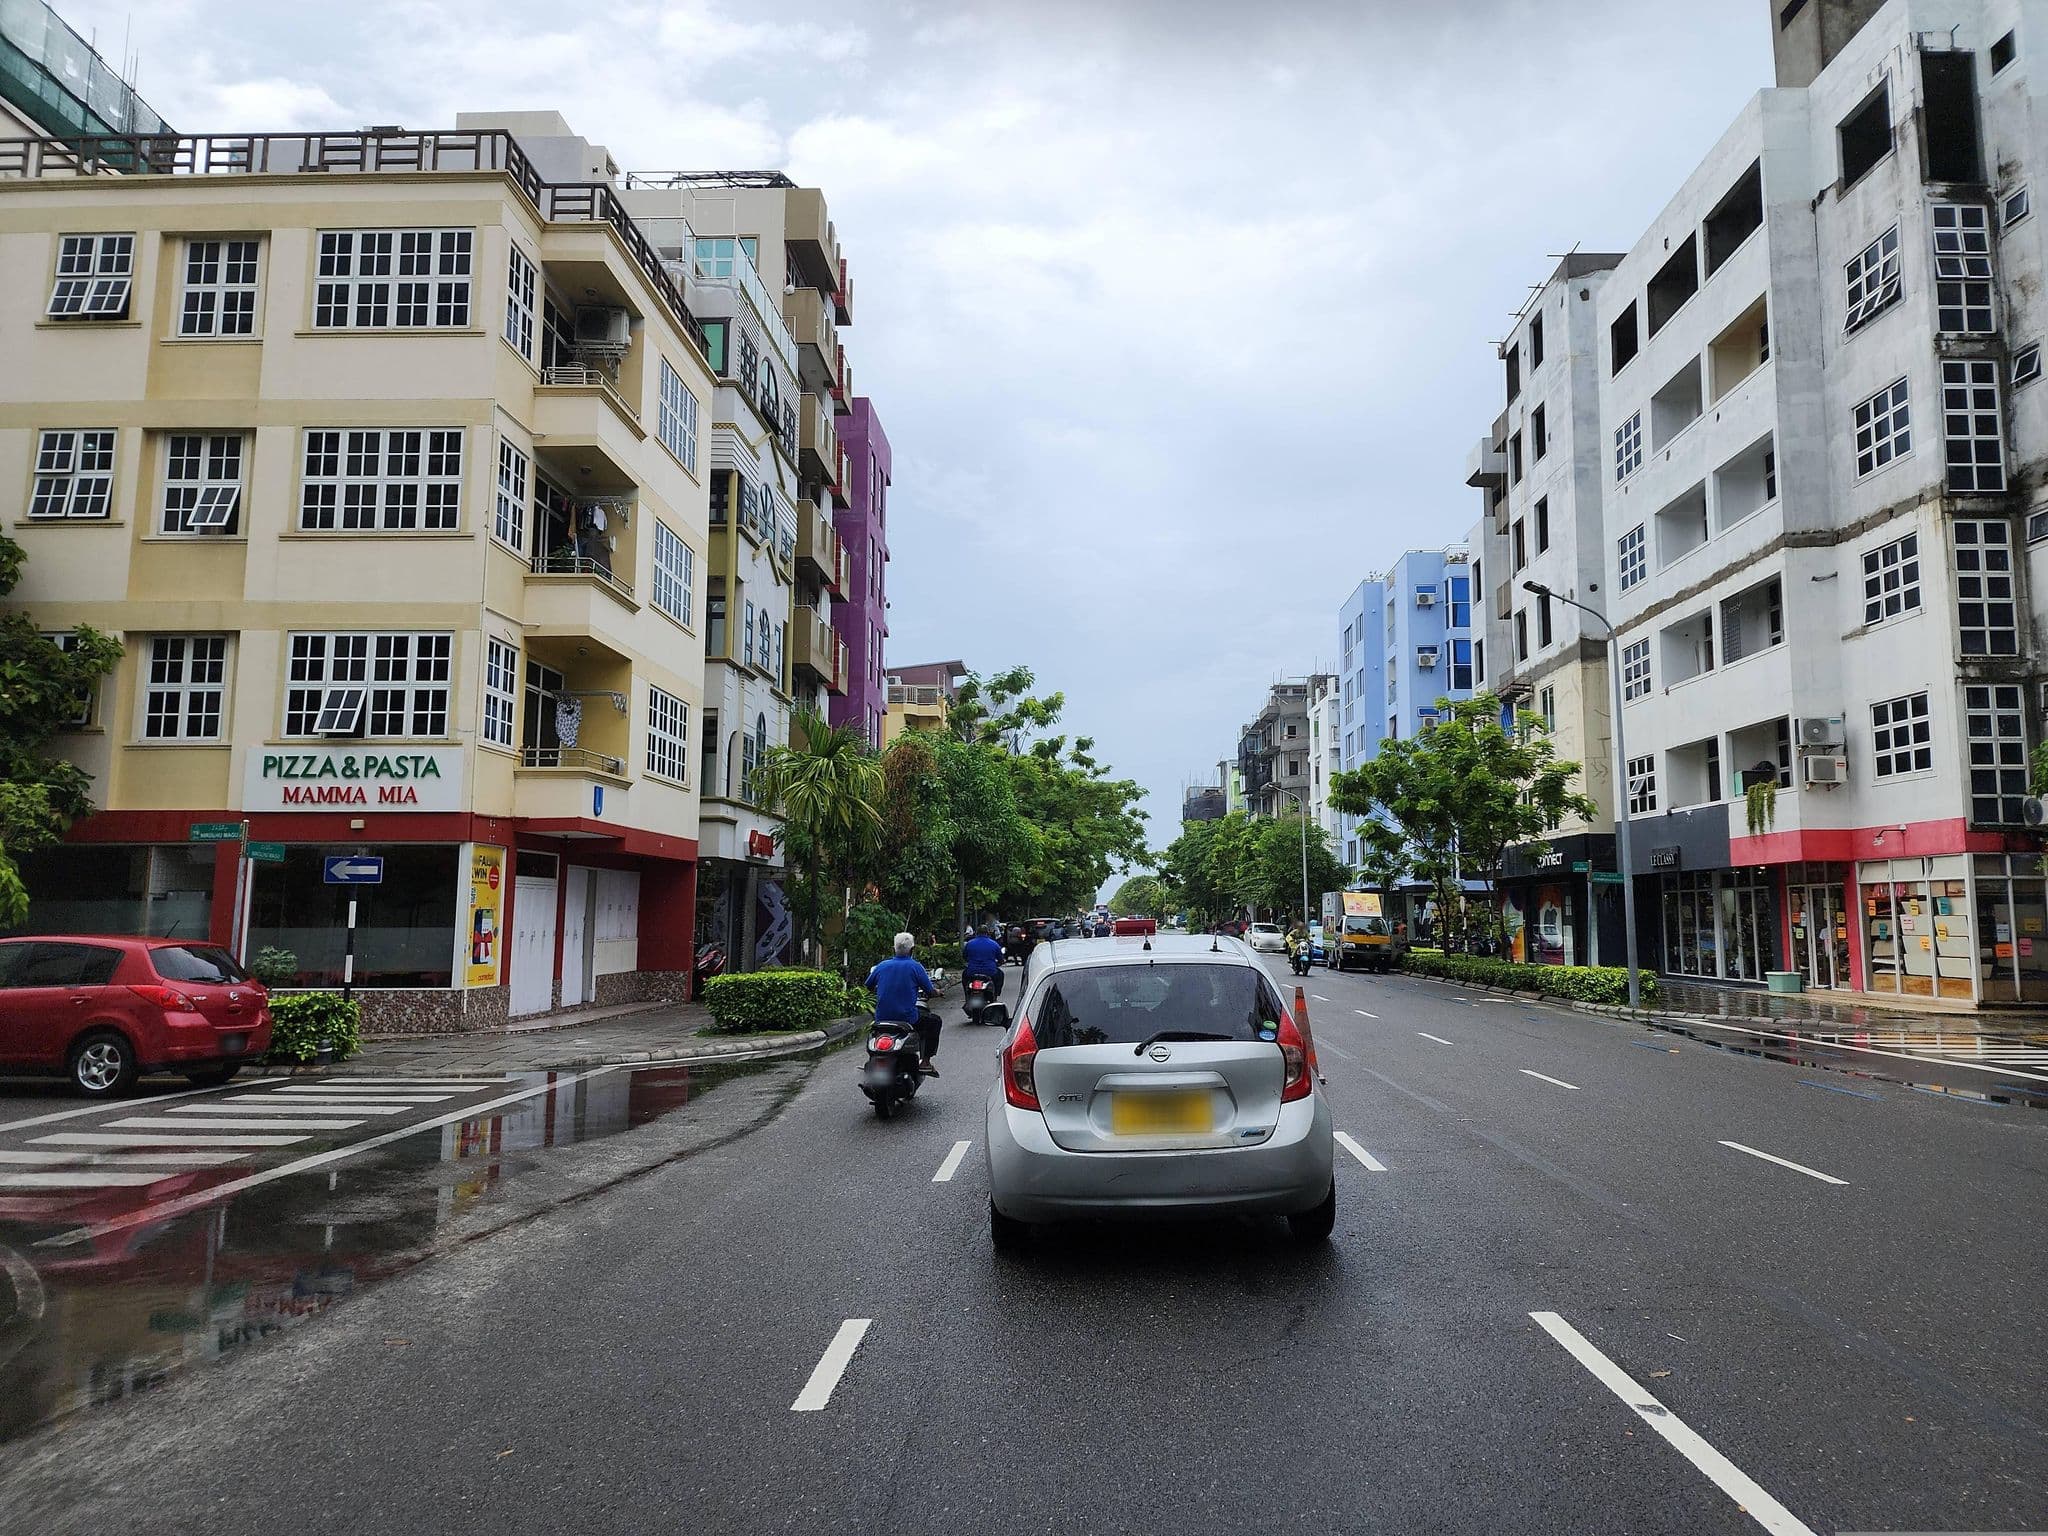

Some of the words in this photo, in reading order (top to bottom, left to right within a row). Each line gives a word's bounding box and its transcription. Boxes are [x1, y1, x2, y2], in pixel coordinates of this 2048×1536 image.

[263, 755, 337, 778] PIZZA
[341, 755, 360, 778] &
[364, 755, 441, 778] PASTA
[282, 786, 367, 804] MAMMA
[377, 786, 418, 804] MIA
[474, 867, 488, 880] WIN
